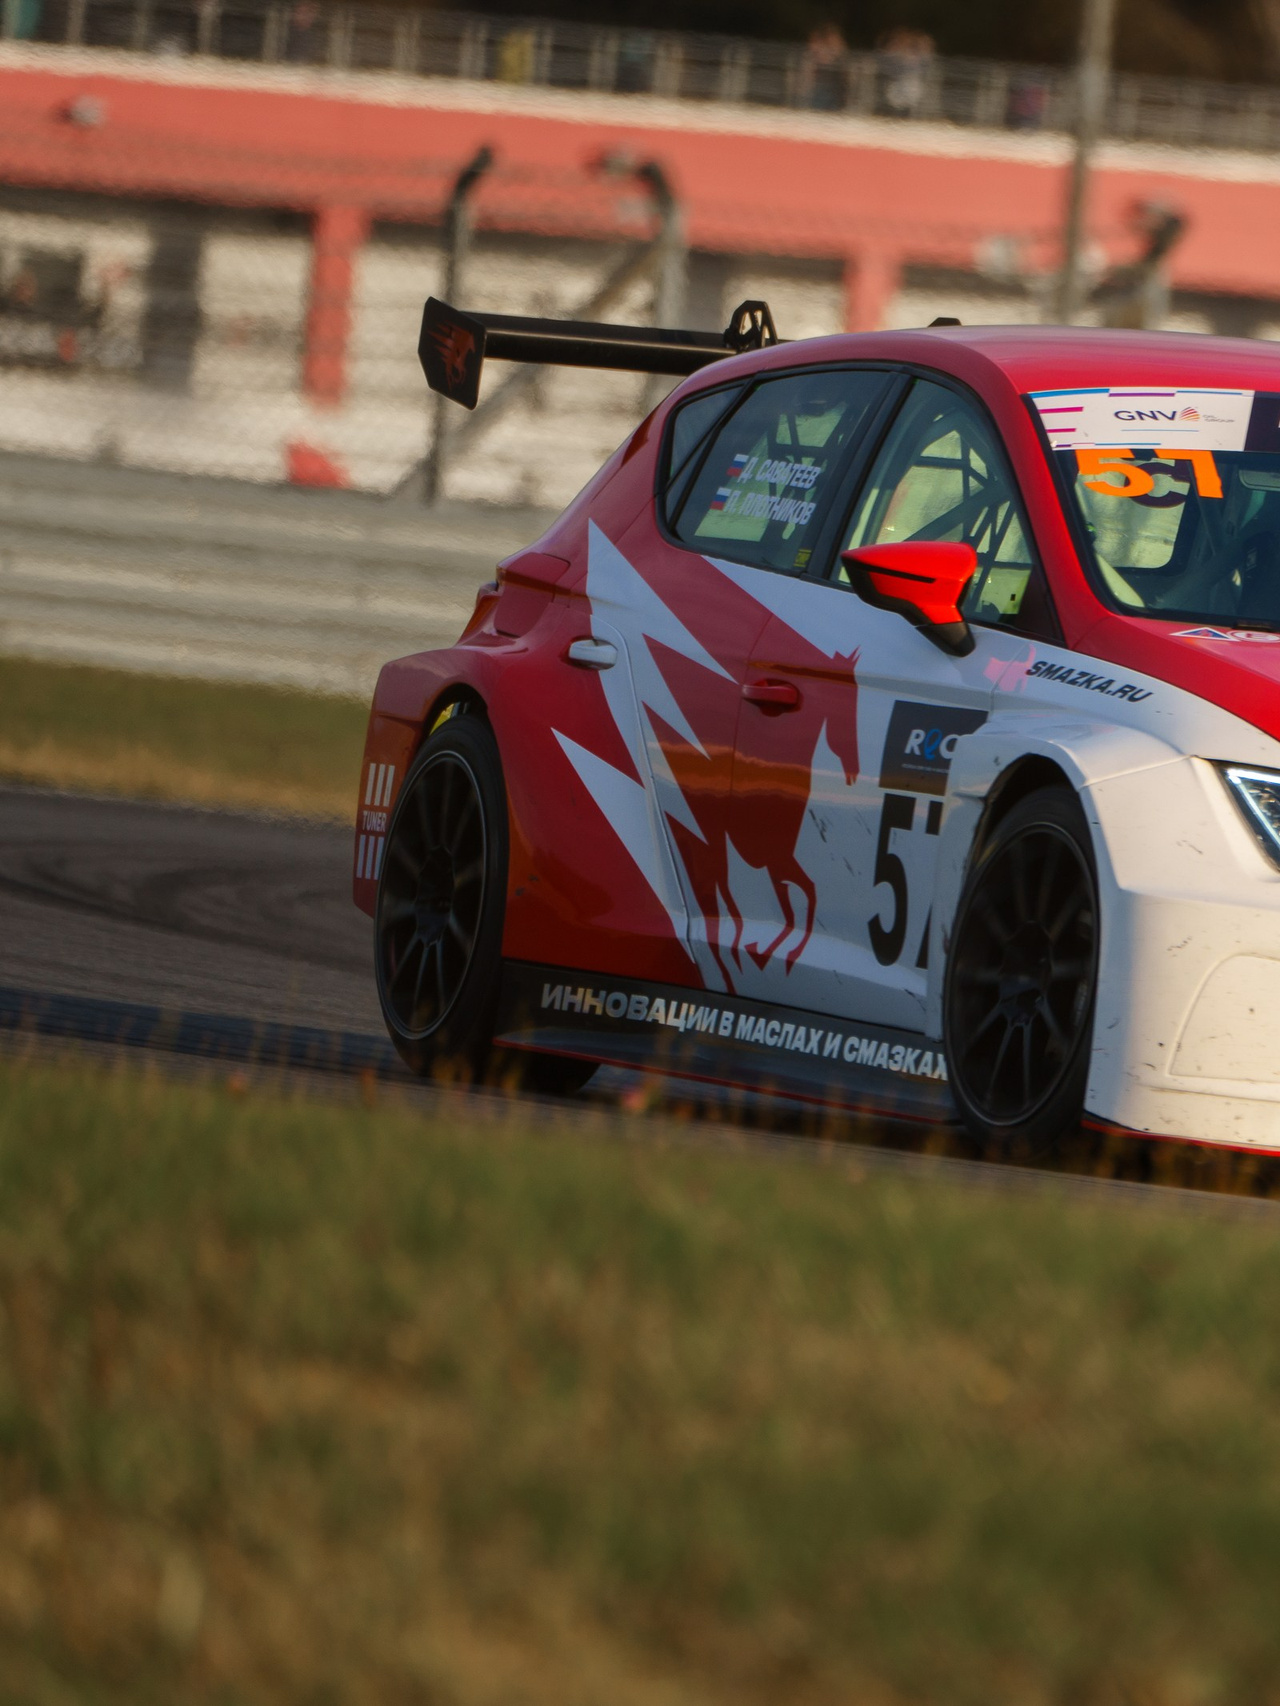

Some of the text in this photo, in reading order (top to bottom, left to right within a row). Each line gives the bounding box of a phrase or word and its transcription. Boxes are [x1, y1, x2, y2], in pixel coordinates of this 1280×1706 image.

[1113, 410, 1177, 421] GNV
[755, 459, 821, 489] САВАТЕЕВ
[1025, 660, 1153, 702] SMAZKA.RU
[362, 810, 387, 832] TUNER
[540, 983, 719, 1034] ИННОВАЦИИ
[718, 1011, 735, 1037] В
[735, 1015, 825, 1056] МАСЛАХ
[822, 1033, 841, 1060] И
